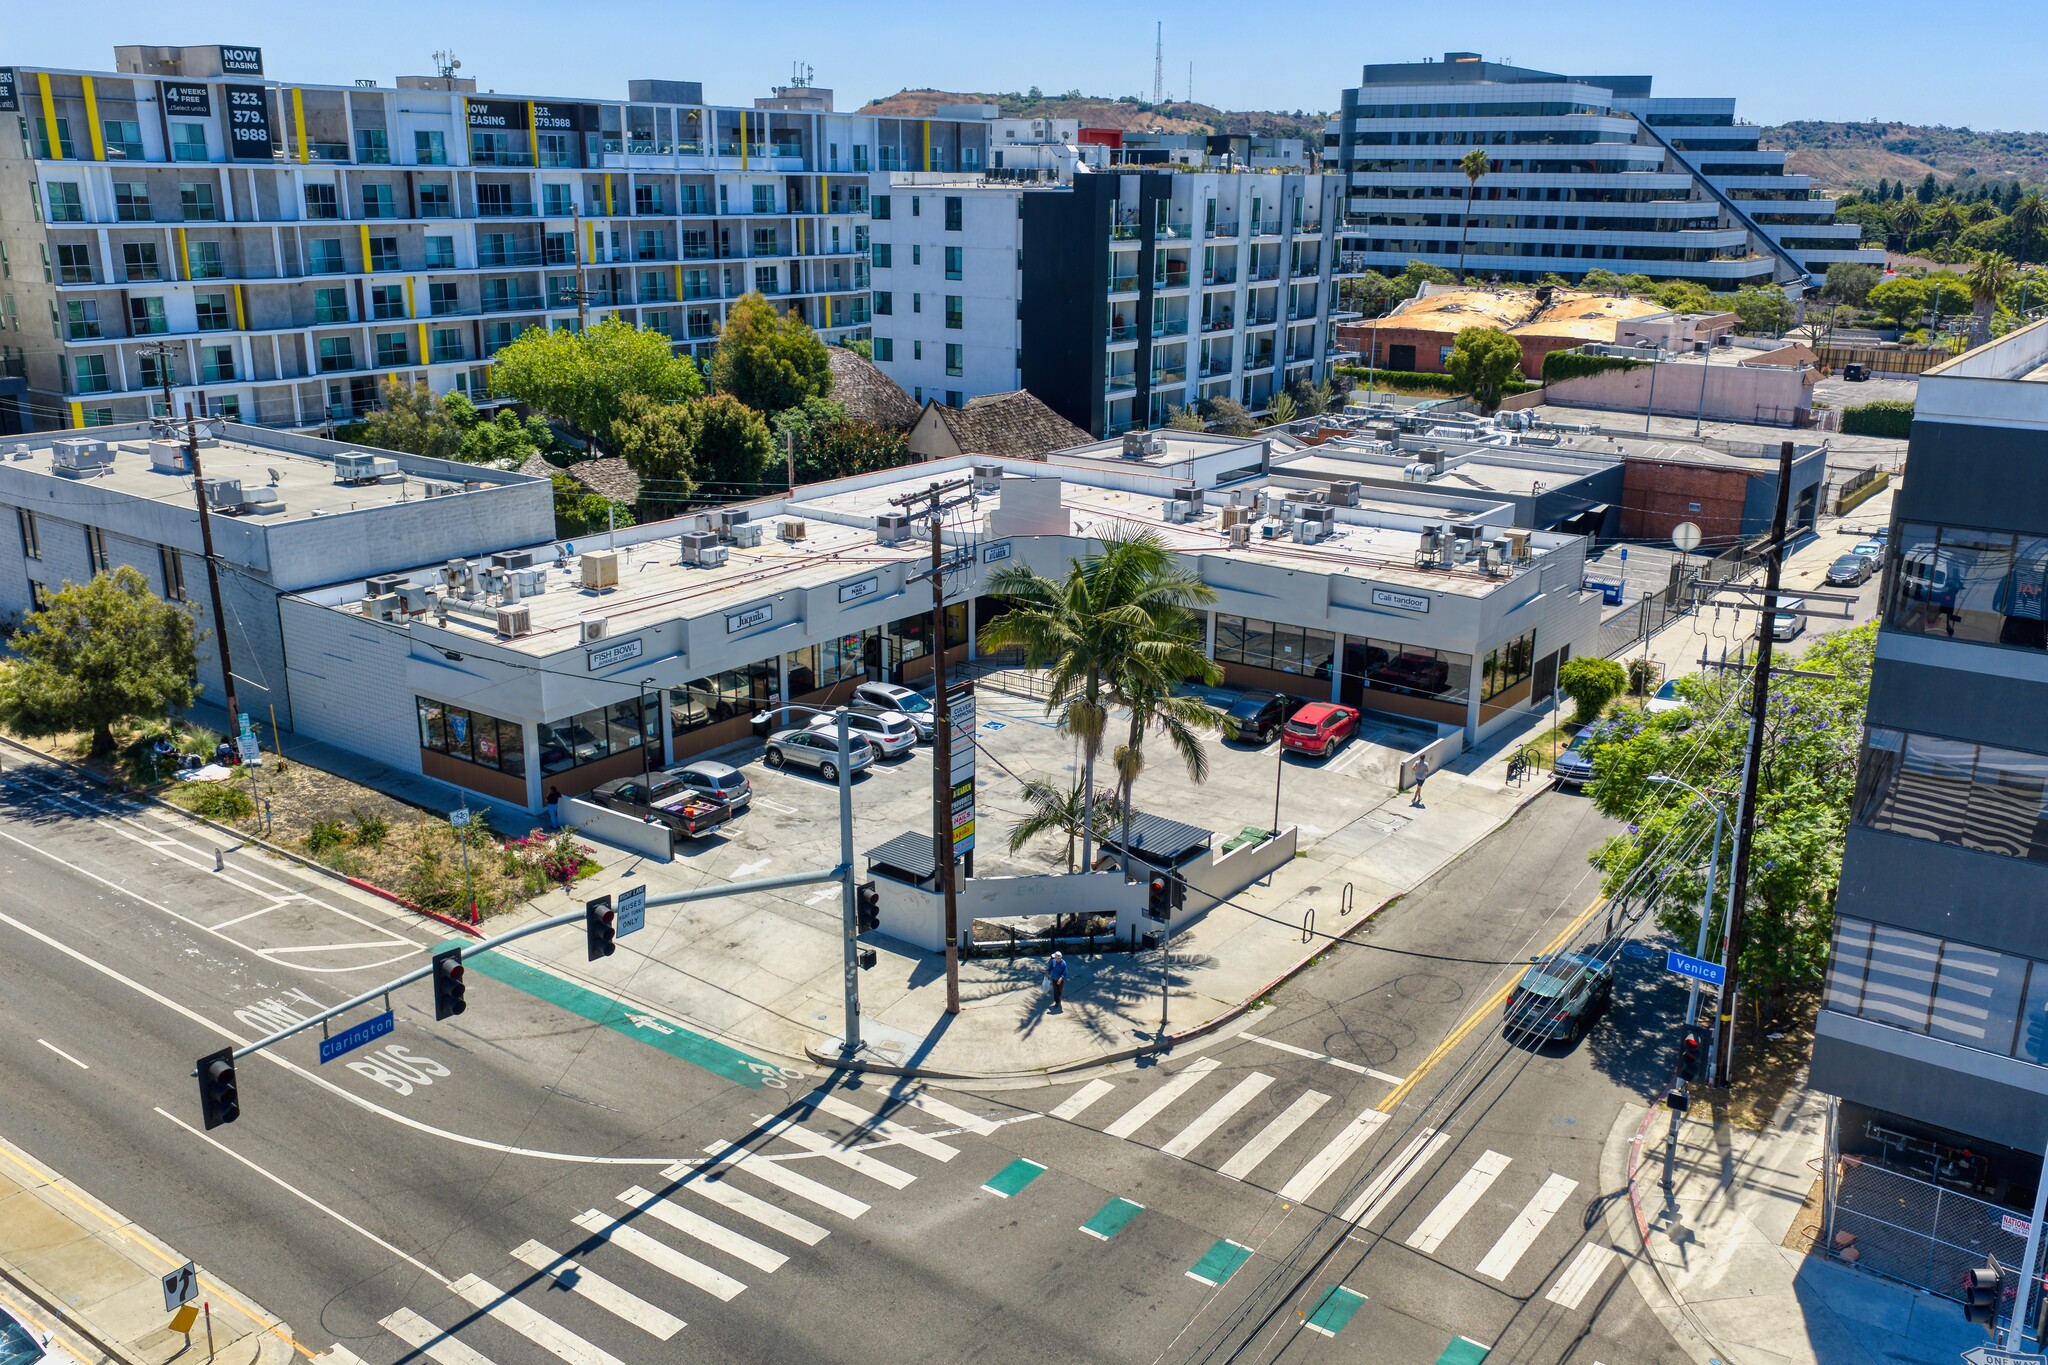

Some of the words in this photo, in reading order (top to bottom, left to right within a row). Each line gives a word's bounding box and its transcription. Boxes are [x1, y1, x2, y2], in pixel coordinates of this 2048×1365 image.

[224, 49, 257, 61] NOW
[225, 62, 258, 70] LEASING
[0, 72, 12, 82] EKS
[167, 87, 179, 101] 4
[231, 92, 262, 105] 323.
[233, 110, 264, 123] 379.
[234, 128, 267, 141] 1988
[1378, 592, 1392, 601] Cali
[1393, 596, 1423, 607] tandoor
[737, 611, 764, 628] Juquila
[593, 650, 612, 662] FISH
[614, 643, 637, 656] BOWL
[953, 702, 972, 715] CULVER
[953, 811, 971, 825] NAILS
[621, 899, 642, 912] BUSES
[622, 917, 639, 928] ONLY
[1677, 958, 1717, 978] Venice
[322, 1018, 392, 1057] Clarington
[345, 1044, 451, 1096] BUS
[2003, 1216, 2031, 1230] NATIONA
